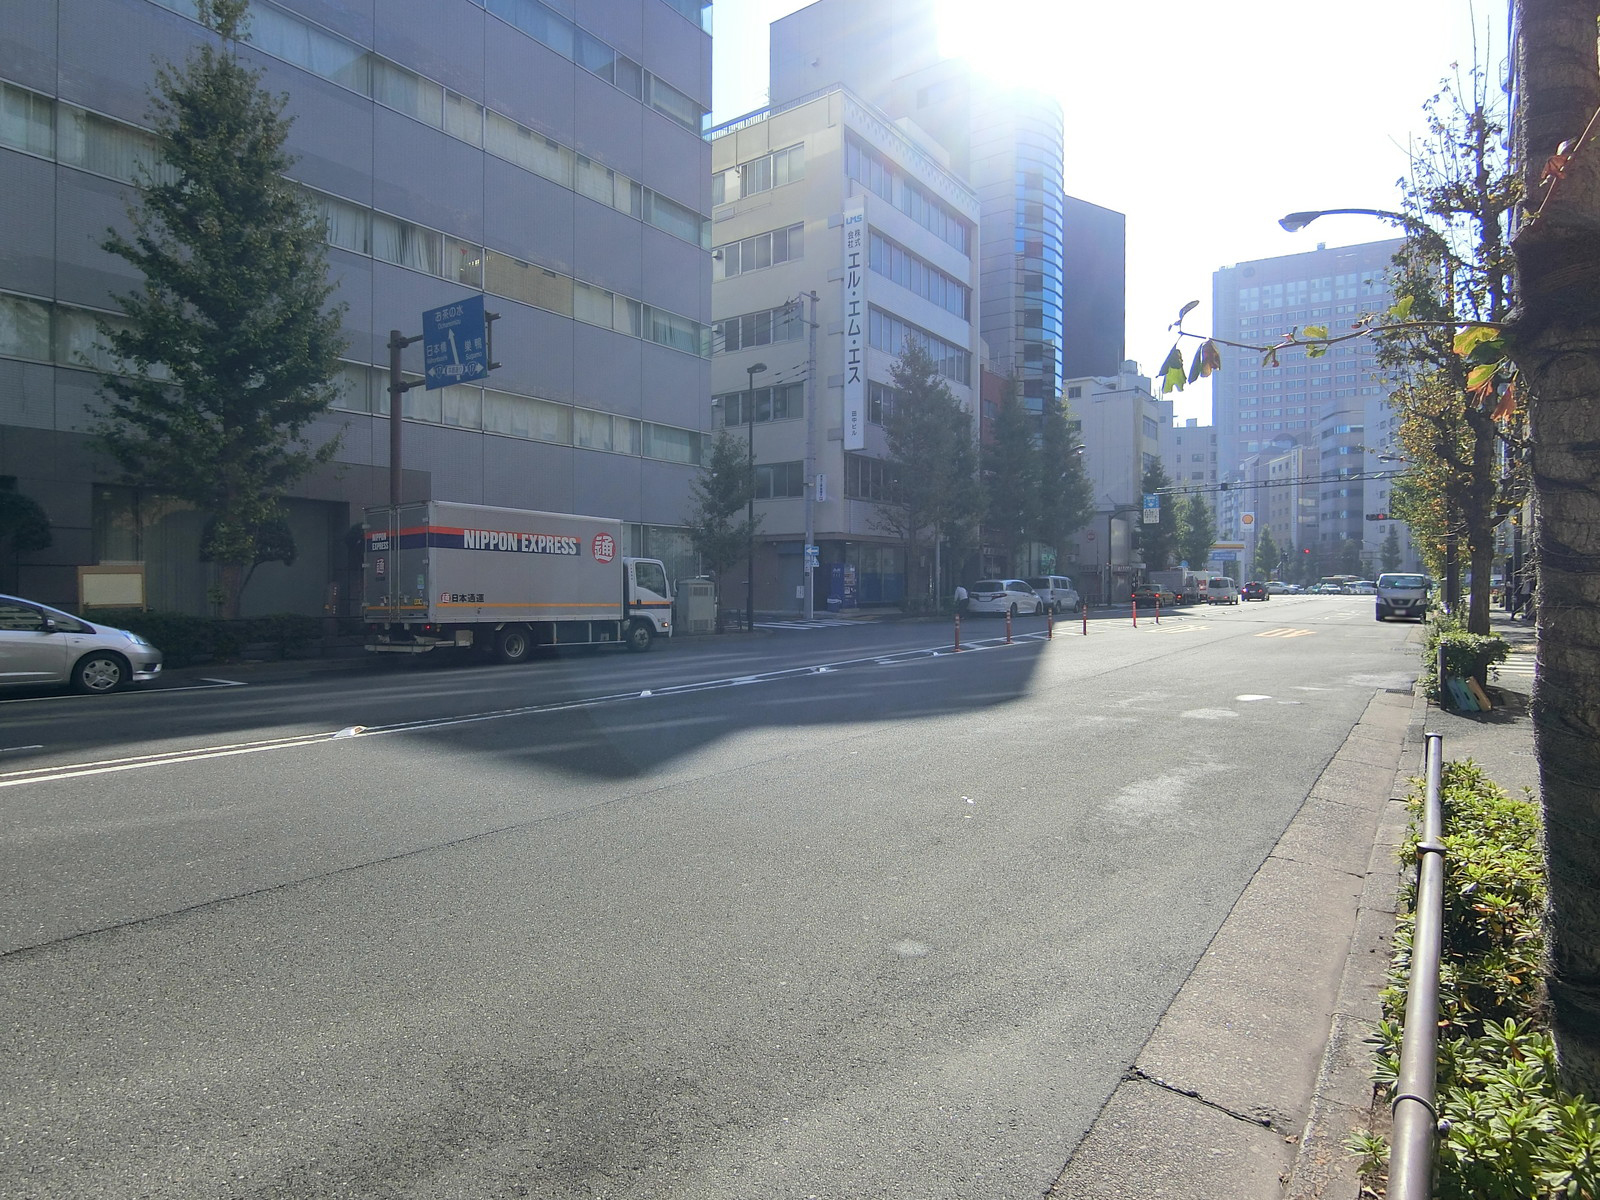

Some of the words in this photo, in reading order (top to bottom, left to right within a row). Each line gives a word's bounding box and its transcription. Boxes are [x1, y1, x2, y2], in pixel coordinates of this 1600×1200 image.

[435, 304, 464, 322] お茶の水
[847, 252, 861, 385] エル・エム・エス
[372, 541, 389, 551] EXPRESS
[463, 529, 518, 552] NIPPON
[522, 534, 577, 555] EXPRESS
[594, 535, 613, 562] 通
[452, 593, 485, 603] 日本通運
